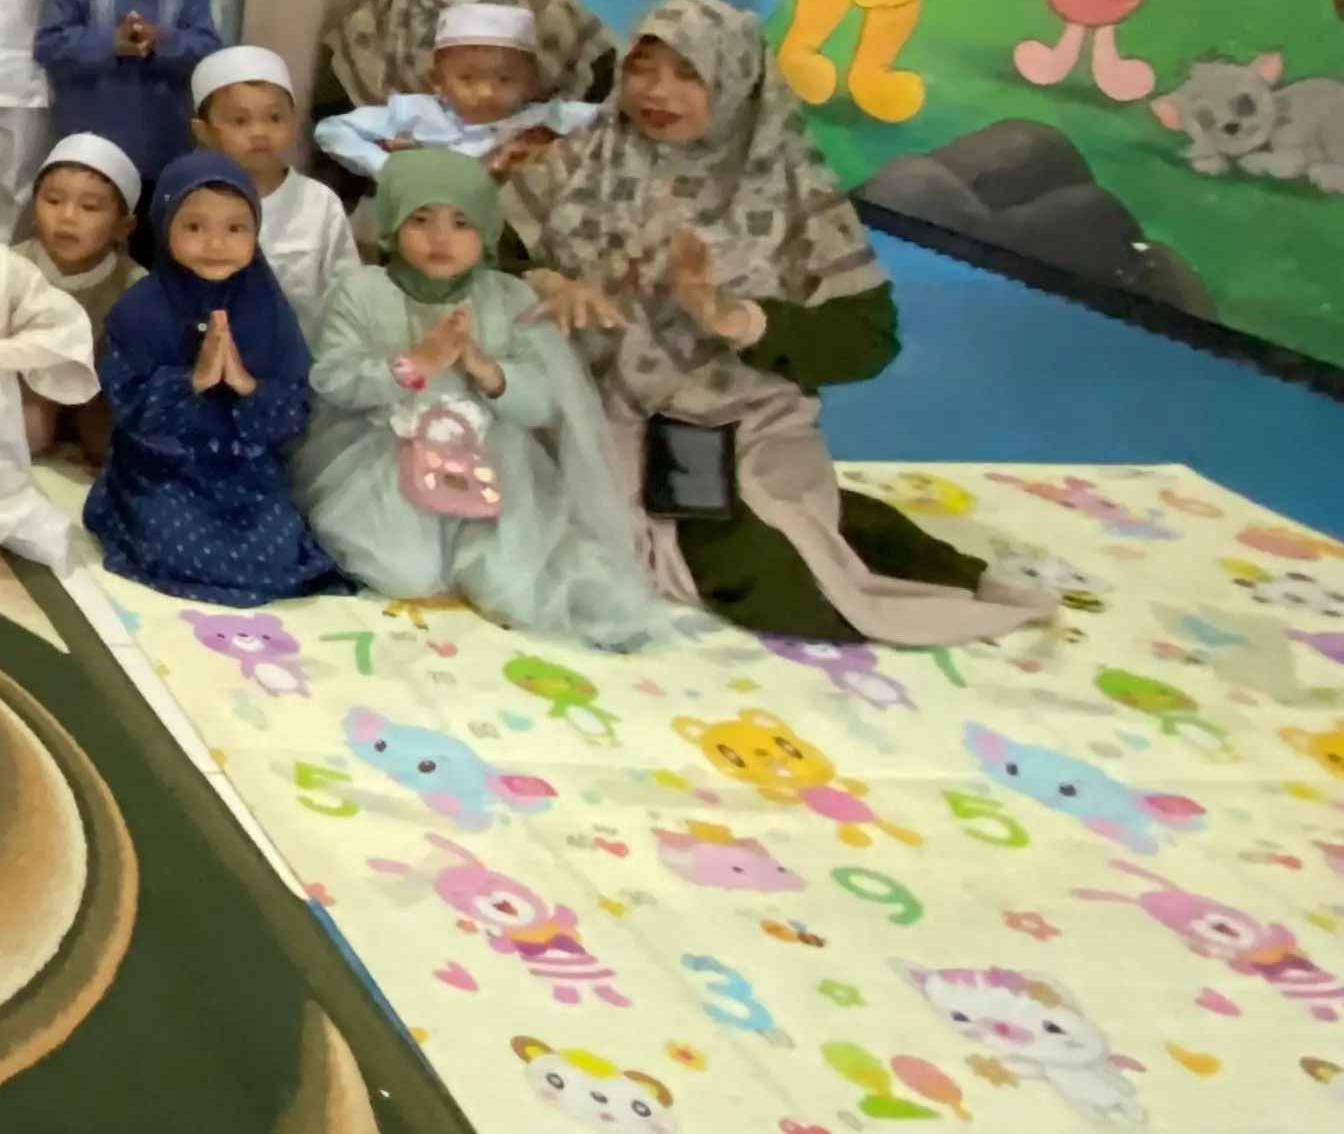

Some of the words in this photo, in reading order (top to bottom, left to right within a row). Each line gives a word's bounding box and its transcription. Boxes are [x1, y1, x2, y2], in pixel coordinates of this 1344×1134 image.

[318, 630, 375, 676] 7
[295, 762, 360, 817] 5
[941, 789, 1031, 849] 5
[829, 866, 924, 927] 9
[681, 953, 775, 1032] 3
